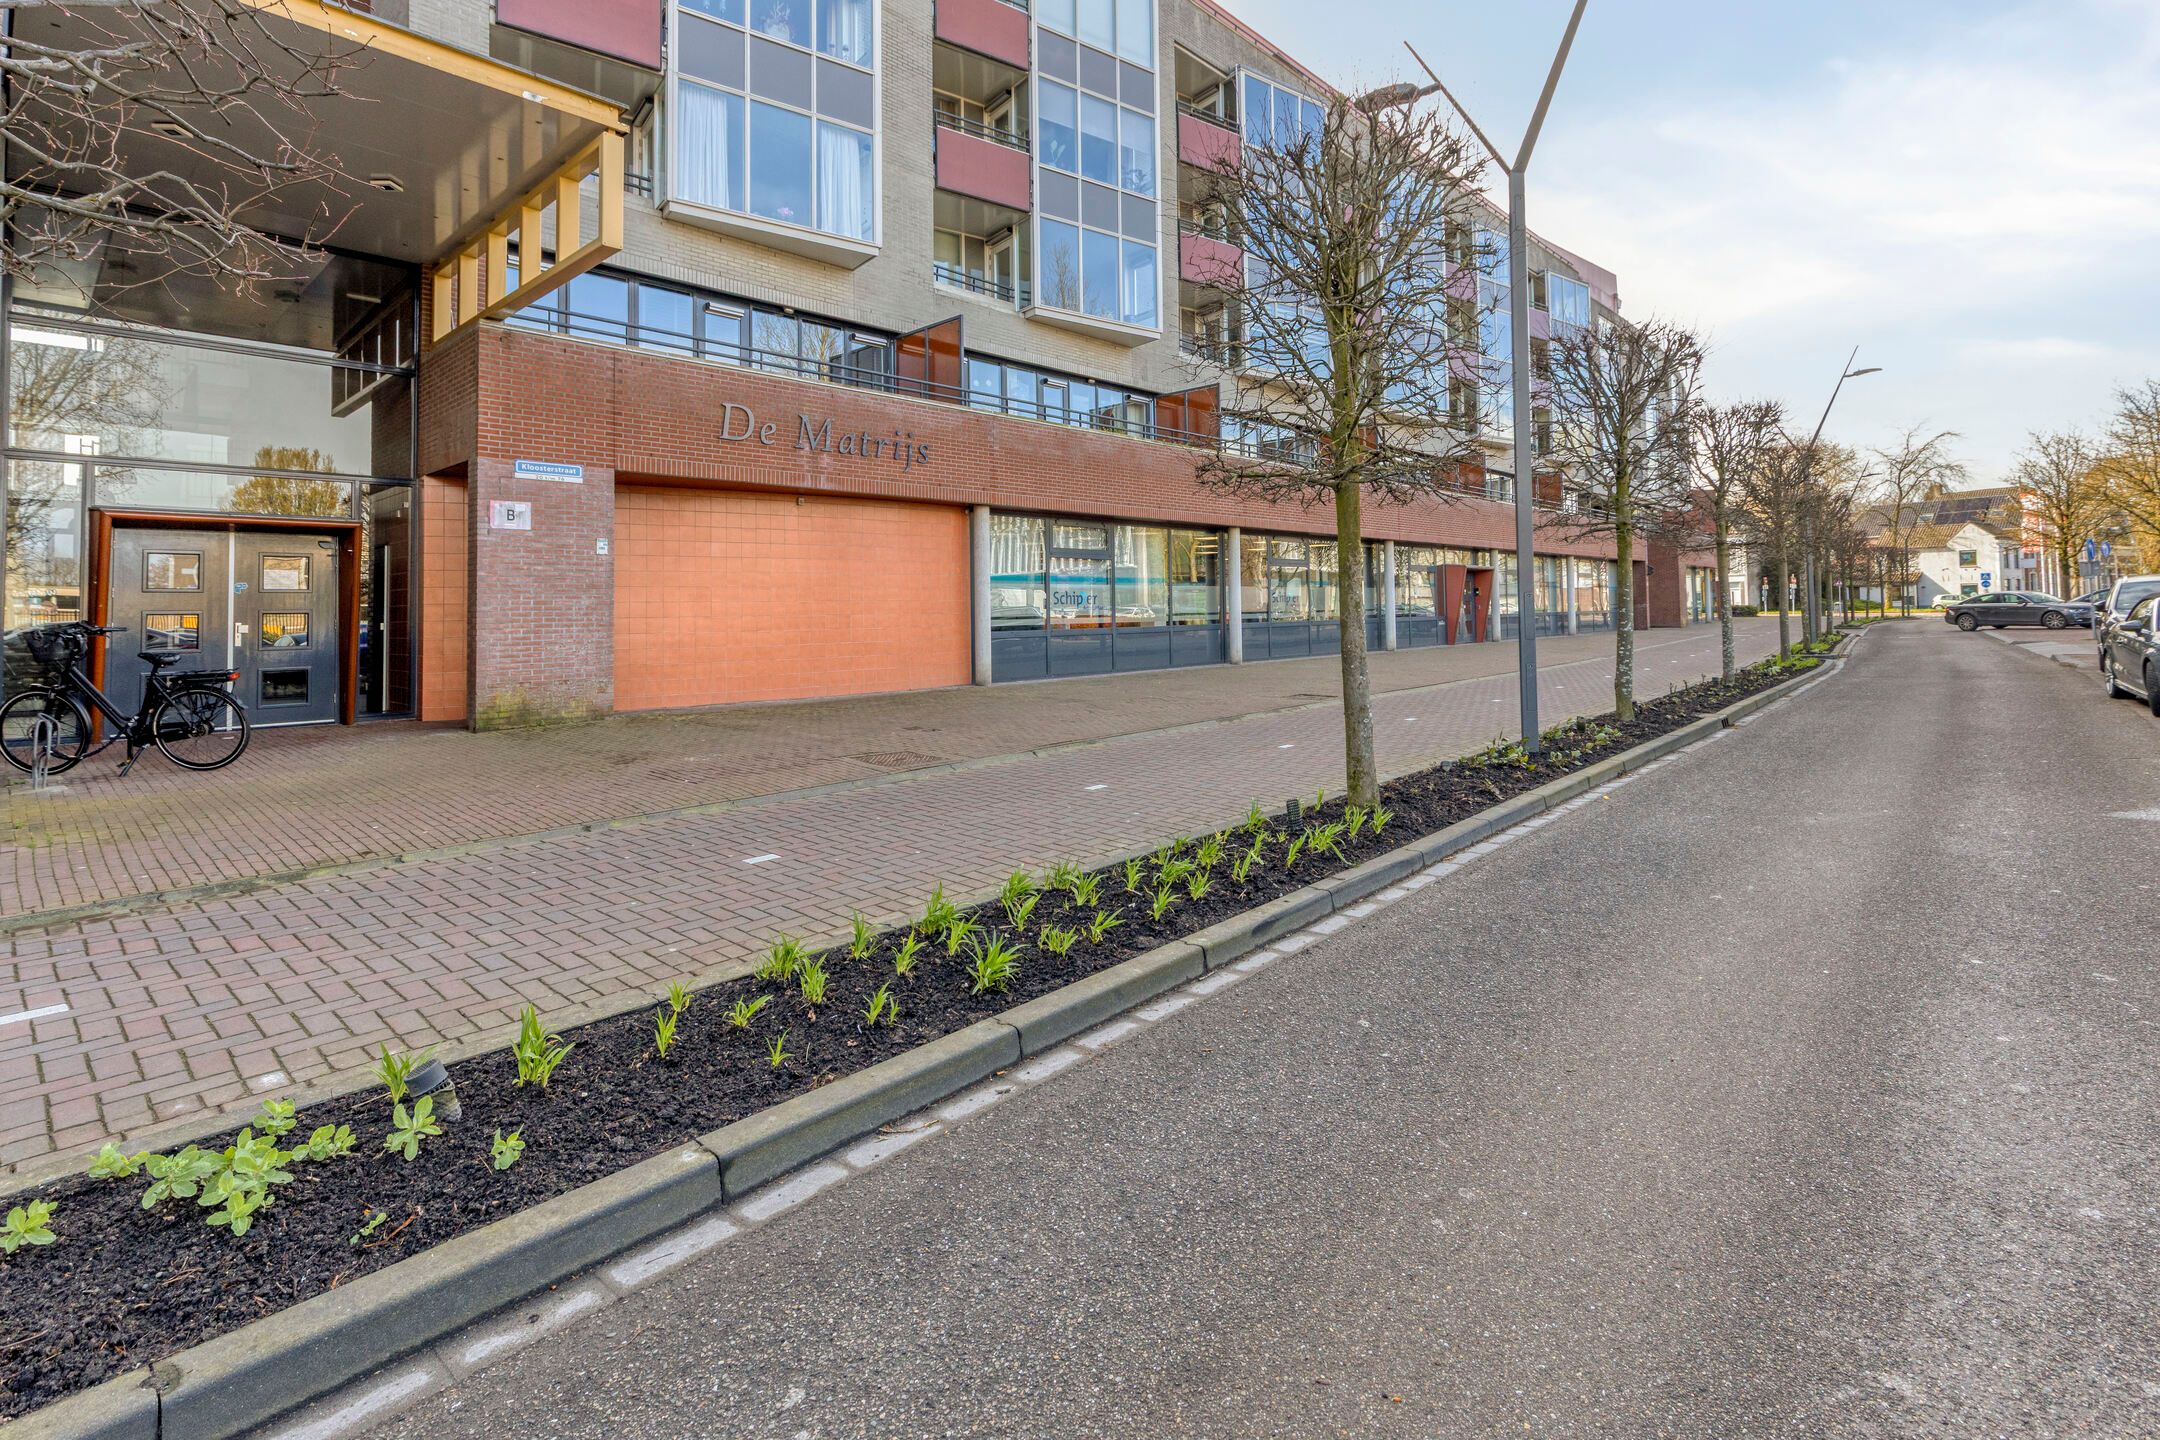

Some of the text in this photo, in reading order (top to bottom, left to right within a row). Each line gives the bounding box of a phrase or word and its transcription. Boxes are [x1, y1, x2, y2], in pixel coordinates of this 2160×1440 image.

[720, 402, 930, 473] De Matrijs
[521, 463, 577, 475] Kloosterstraat
[507, 509, 515, 521] B
[1053, 590, 1098, 609] Schiper
